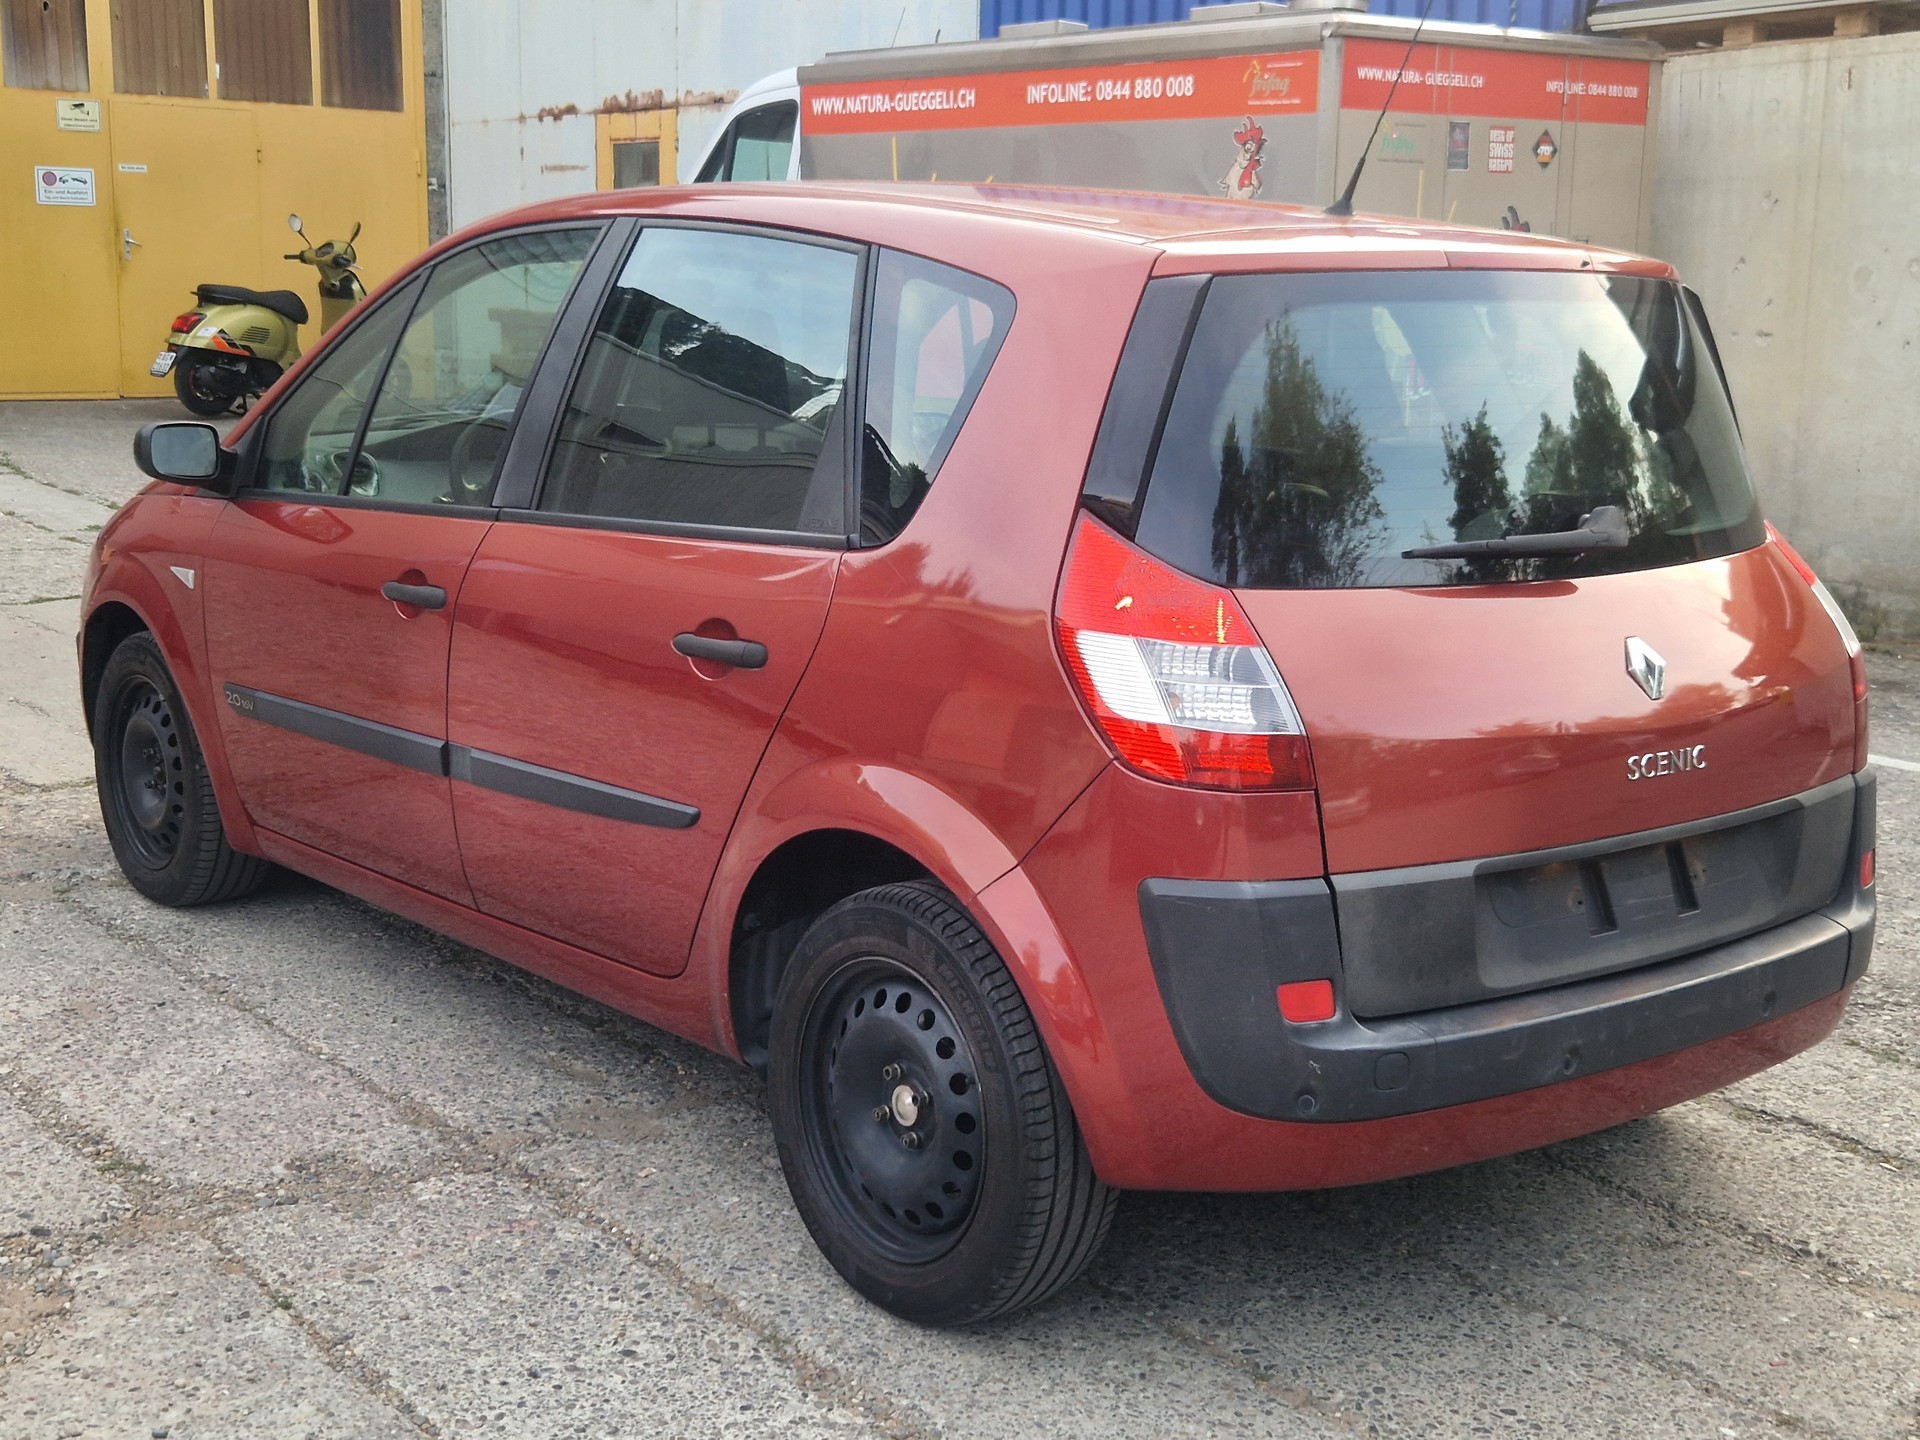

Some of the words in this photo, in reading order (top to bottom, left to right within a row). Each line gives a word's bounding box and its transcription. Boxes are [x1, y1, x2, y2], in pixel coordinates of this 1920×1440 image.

[812, 89, 976, 116] WWW.NATURA-GUEGGELI.CH
[1027, 80, 1092, 104] INFOLINE:
[1096, 80, 1130, 101] 0844
[1134, 78, 1162, 99] 880
[1166, 75, 1194, 97] 008
[1588, 83, 1606, 96] 0844
[1608, 84, 1622, 97] 880
[1623, 86, 1638, 98] 008
[1627, 745, 1707, 780] SCENIC
